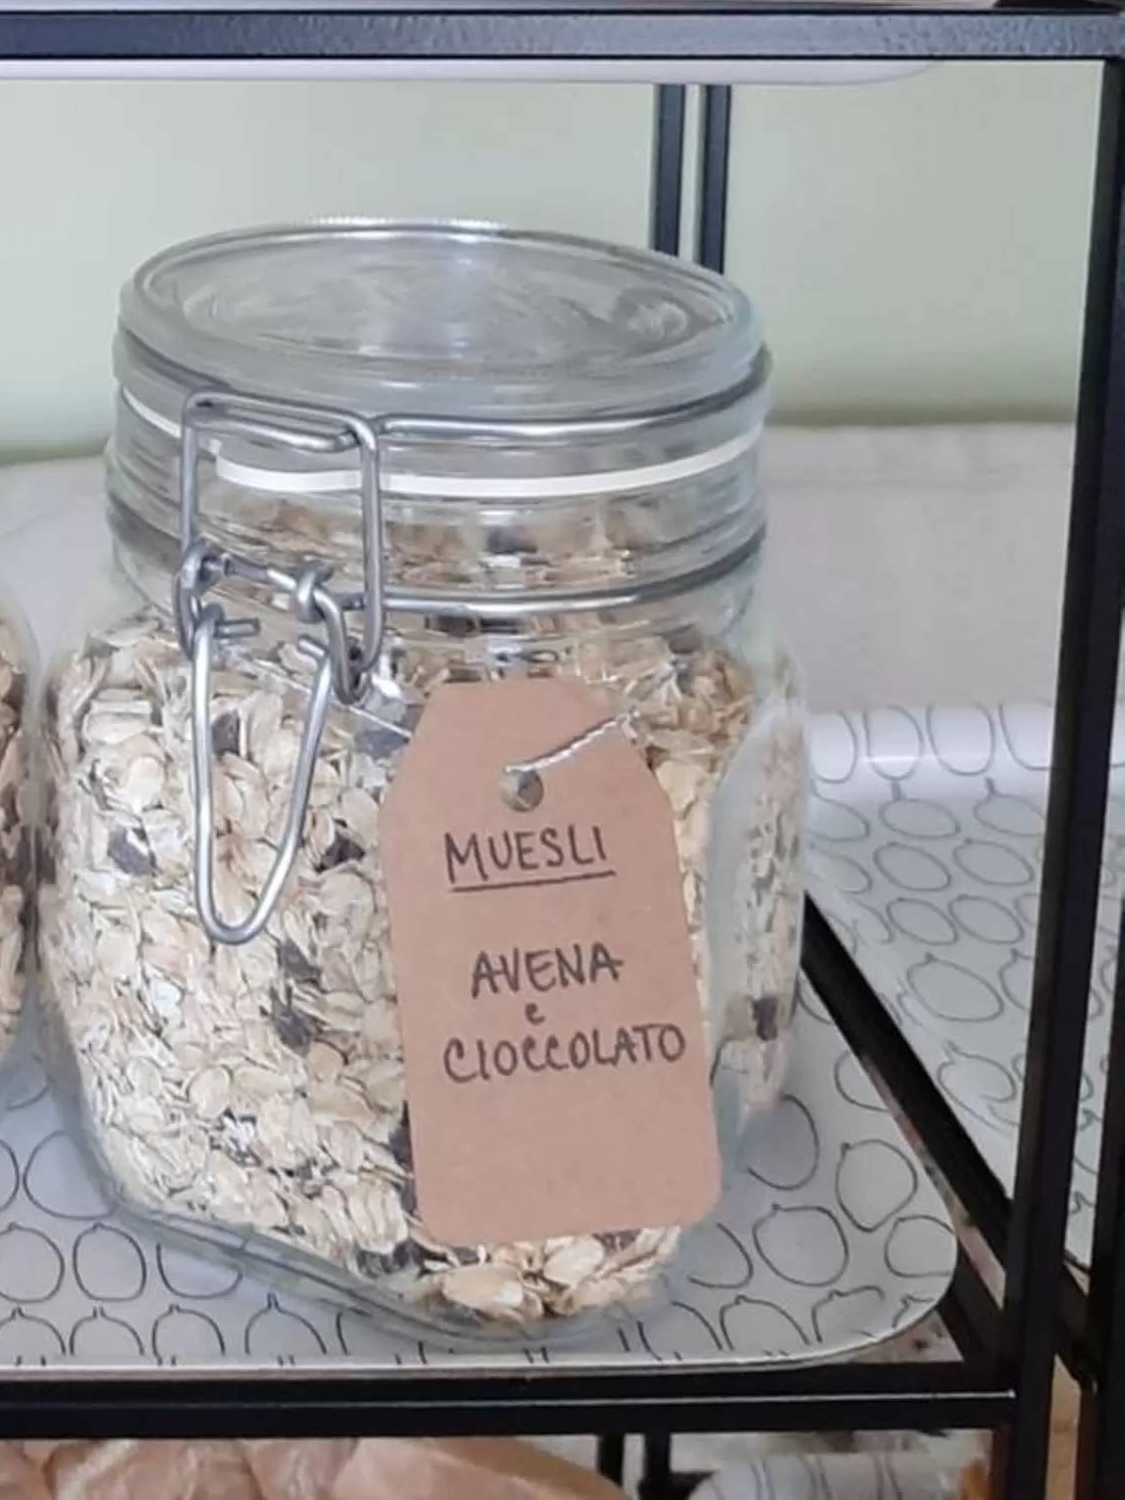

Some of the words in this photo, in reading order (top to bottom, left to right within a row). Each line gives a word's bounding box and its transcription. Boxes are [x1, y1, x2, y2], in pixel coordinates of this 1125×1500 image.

[444, 825, 607, 884] MUESLI
[471, 942, 623, 999] AVENA
[525, 1002, 546, 1025] e
[443, 1022, 686, 1084] CIOCCOLATO
